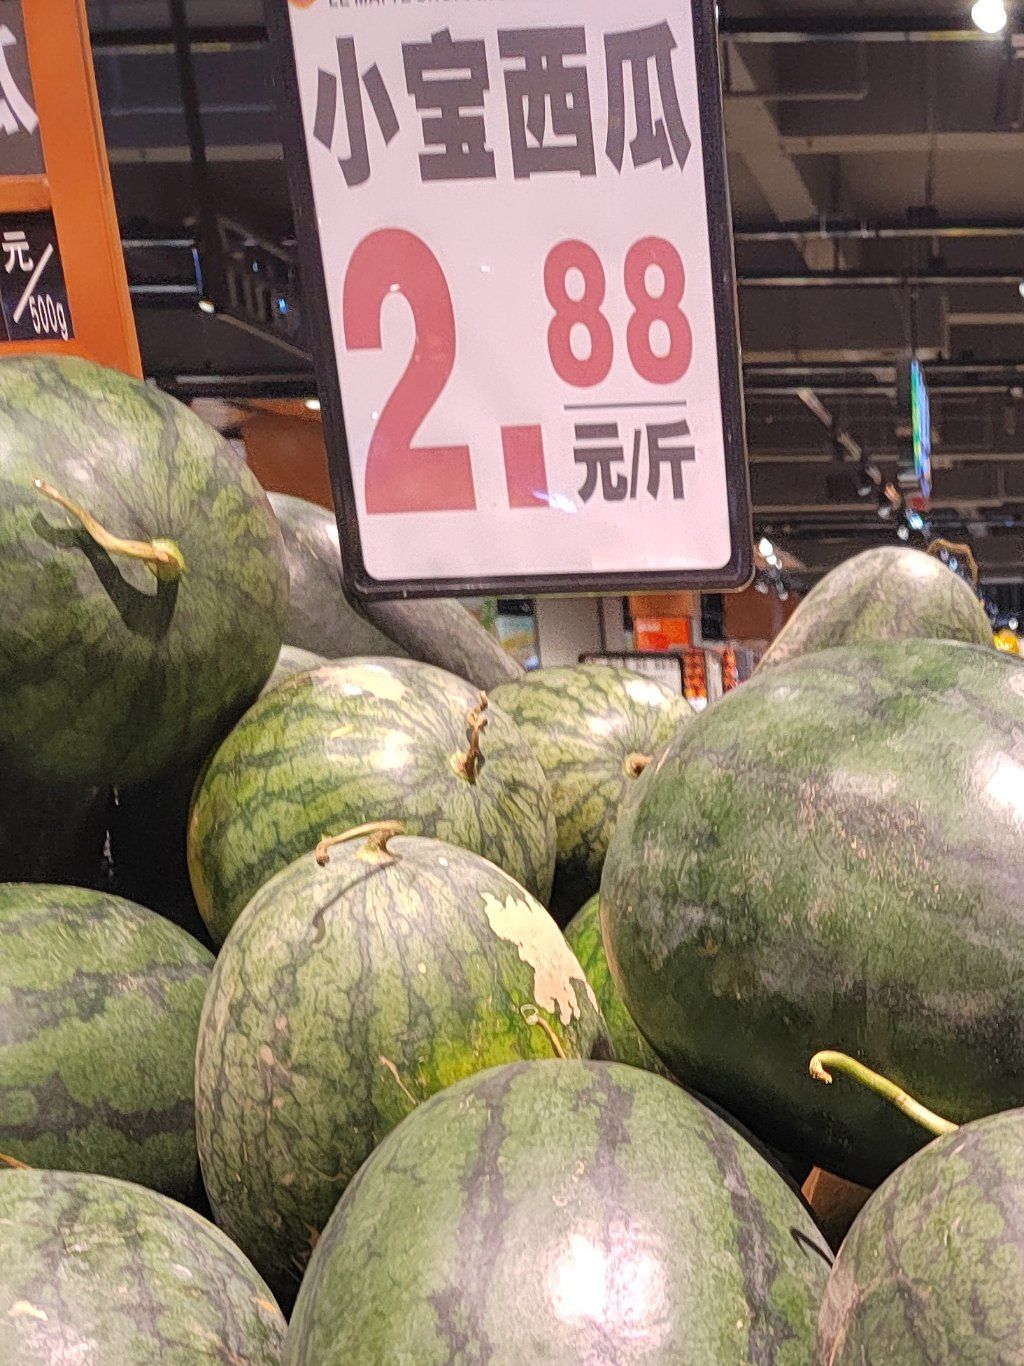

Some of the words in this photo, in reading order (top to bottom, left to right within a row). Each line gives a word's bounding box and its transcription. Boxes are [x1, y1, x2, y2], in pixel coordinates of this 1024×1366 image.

[313, 20, 692, 190] 小宝西瓜
[342, 226, 693, 515] 2.88
[573, 419, 696, 503] 元/斤
